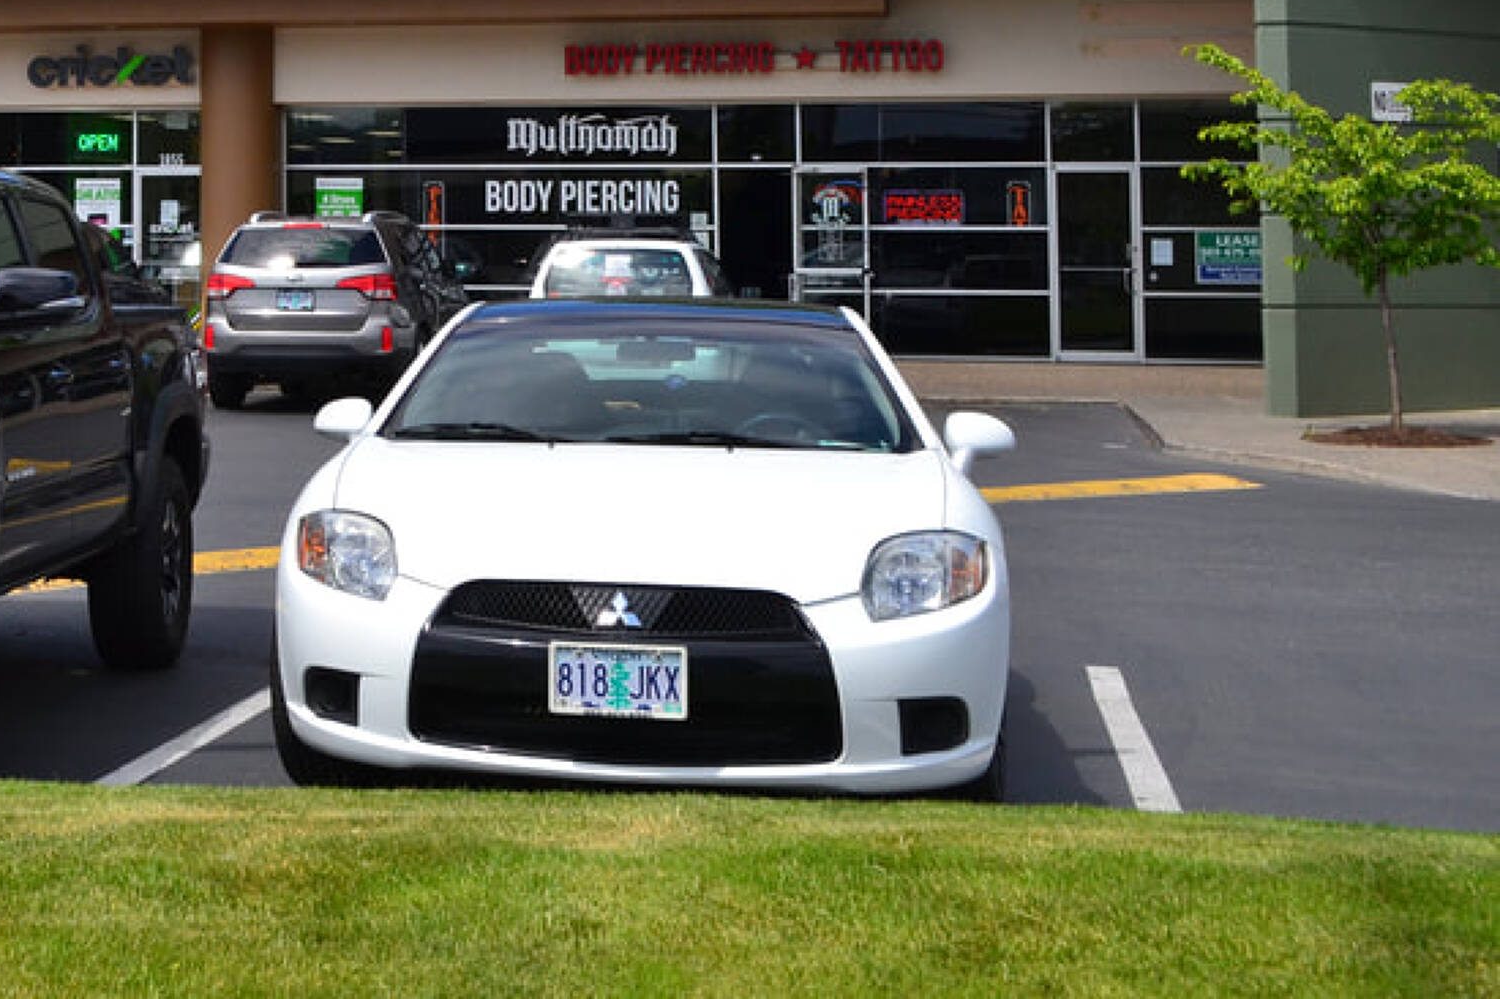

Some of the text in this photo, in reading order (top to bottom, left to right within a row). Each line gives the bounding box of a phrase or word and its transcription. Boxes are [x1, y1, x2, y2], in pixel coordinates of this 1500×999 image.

[28, 44, 193, 87] cricket
[565, 40, 944, 76] BODY PIERCING TATTOO
[78, 134, 119, 151] OPEN
[507, 115, 677, 157] Multnomah
[485, 180, 680, 214] BODY PIERCING
[558, 663, 681, 701] 818 JKX
